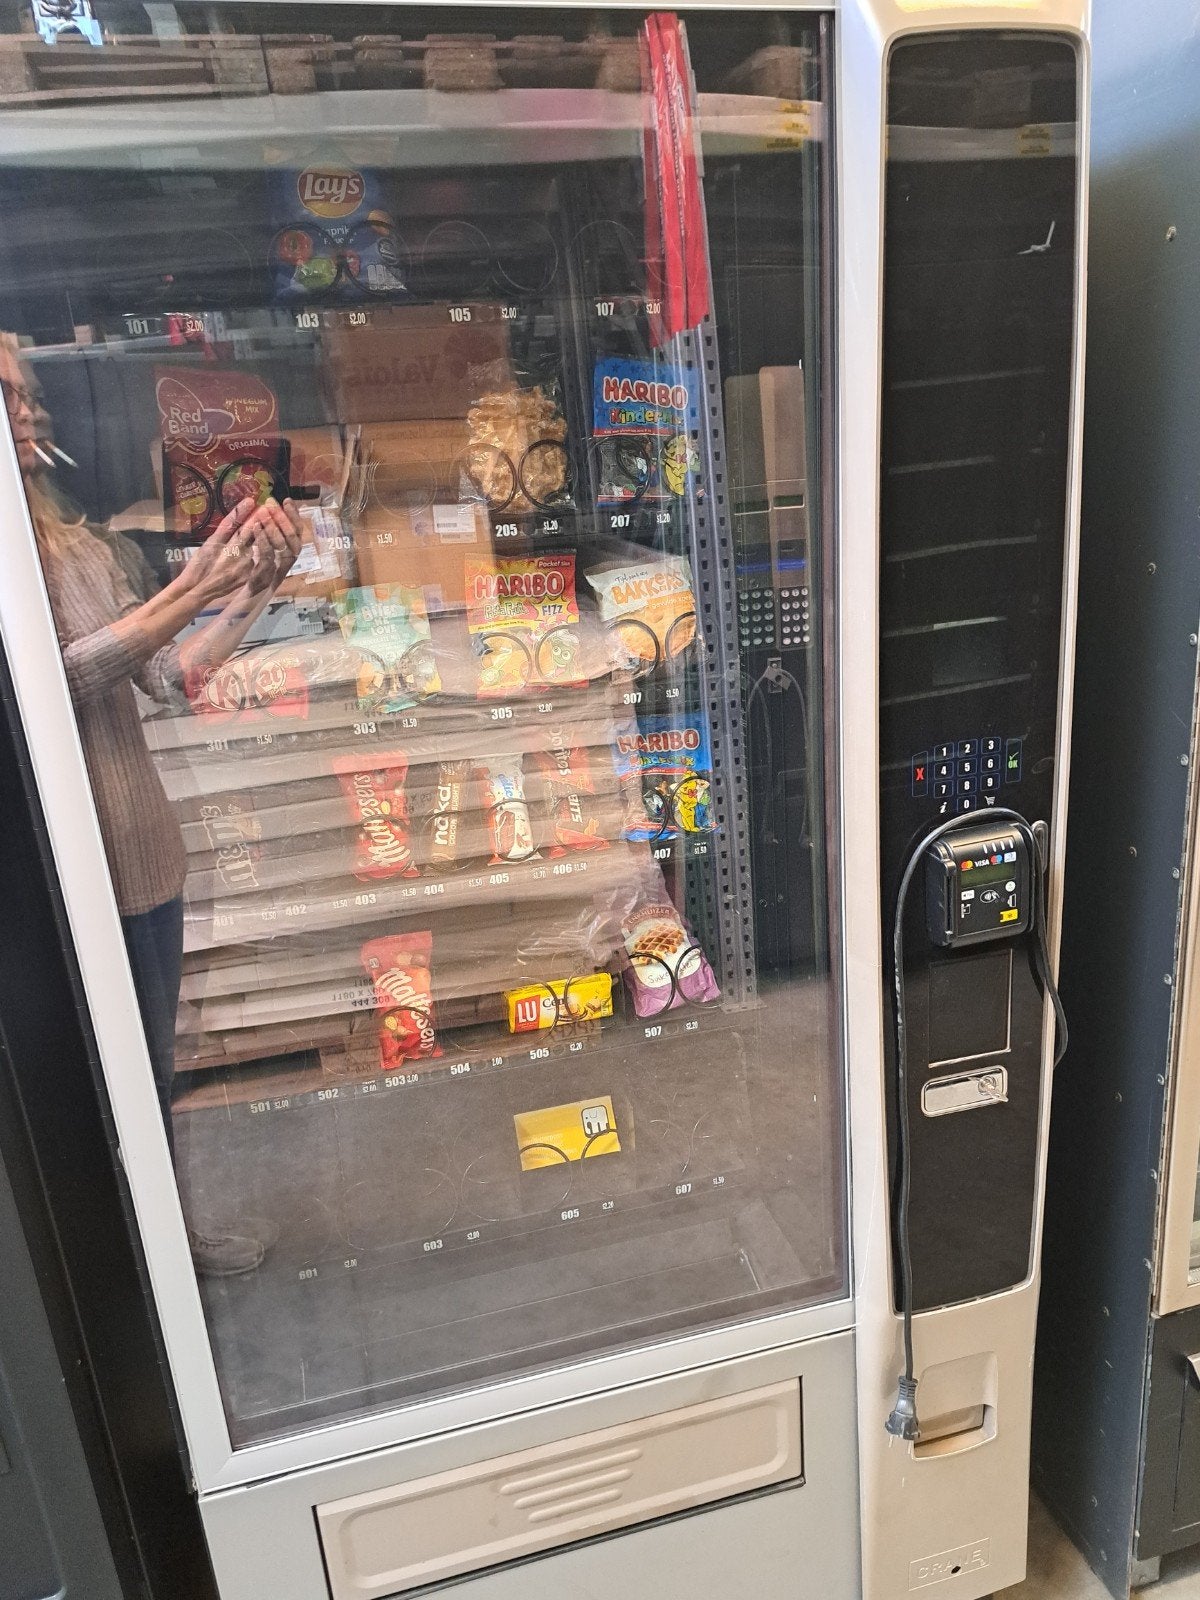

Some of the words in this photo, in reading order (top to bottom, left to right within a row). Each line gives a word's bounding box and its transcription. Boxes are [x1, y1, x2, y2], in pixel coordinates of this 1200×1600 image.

[303, 173, 360, 204] Lay's
[449, 307, 471, 322] 105
[596, 303, 615, 316] 107
[125, 319, 149, 334] 101
[296, 313, 319, 328] 103
[603, 376, 688, 410] HARIBO
[170, 406, 202, 424] Red
[168, 418, 209, 435] Band
[229, 439, 270, 452] ORIGINAL
[611, 515, 630, 528] 207
[496, 523, 518, 537] 205
[328, 537, 350, 550] 203
[475, 571, 565, 599] HARIBO
[541, 604, 563, 616] FIZZ
[623, 691, 642, 704] 307
[490, 706, 513, 720] 305
[353, 722, 377, 735] 303
[206, 740, 229, 752] 301
[617, 728, 701, 754] HARIBO
[942, 746, 947, 757] 1
[964, 743, 971, 754] 2
[988, 740, 994, 750] 3
[940, 765, 947, 775] 4
[964, 762, 971, 772] 5
[987, 758, 994, 769] 6
[1007, 760, 1018, 769] OK
[941, 784, 946, 794] 7
[964, 780, 970, 790] 8
[987, 777, 993, 787] 9
[451, 783, 460, 812] ELIGHT
[963, 799, 970, 809] 0
[568, 793, 583, 823] BITS
[653, 848, 671, 860] 407
[552, 863, 573, 875] 406
[974, 858, 991, 868] VISA
[489, 872, 510, 885] 405
[424, 884, 445, 896] 404
[355, 893, 377, 906] 403
[285, 904, 307, 916] 402
[517, 1000, 537, 1024] LU
[644, 1025, 662, 1038] 507
[529, 1047, 550, 1060] 505
[450, 1062, 471, 1075] 504
[385, 1076, 406, 1088] 503
[317, 1088, 339, 1100] 502
[250, 1103, 271, 1114] 501
[675, 1183, 692, 1195] 607
[561, 1208, 580, 1221] 605
[423, 1239, 443, 1252] 603
[299, 1267, 319, 1280] 601
